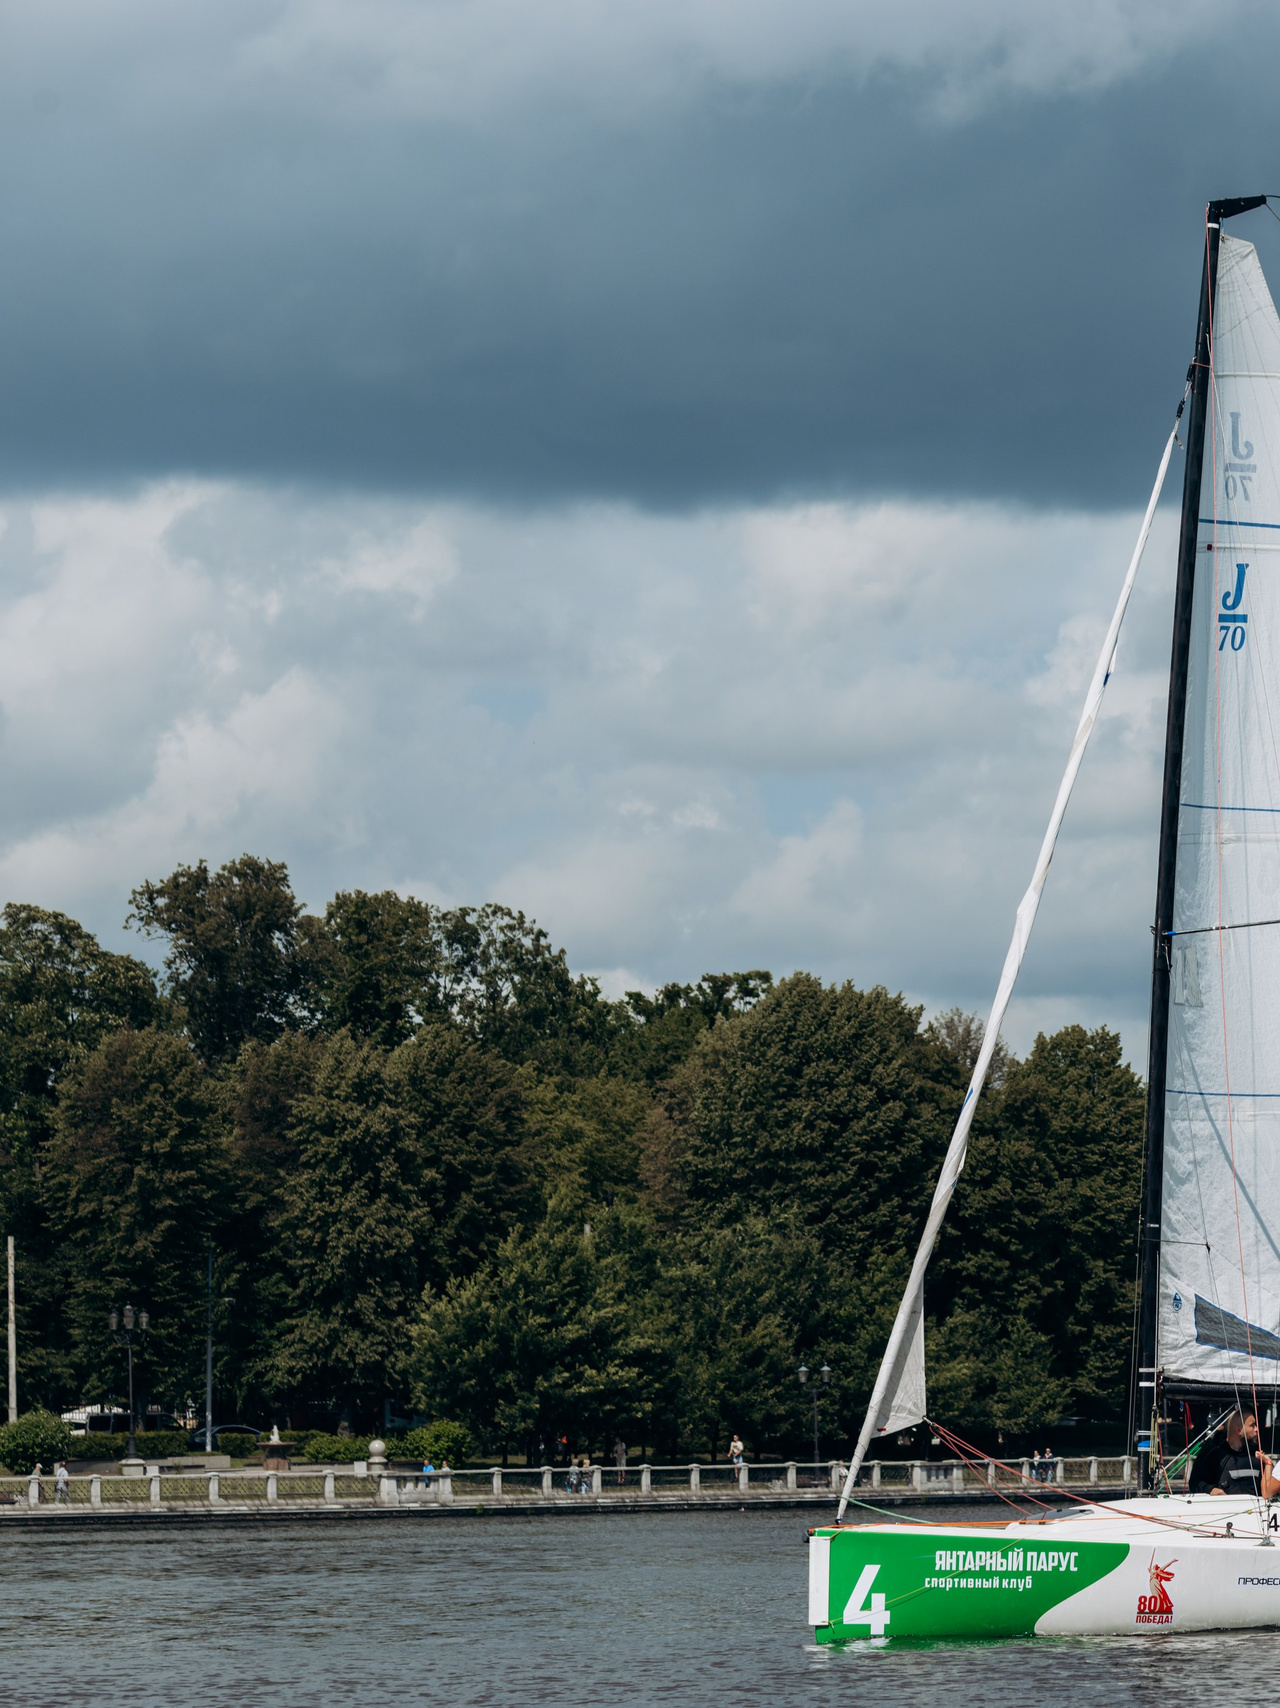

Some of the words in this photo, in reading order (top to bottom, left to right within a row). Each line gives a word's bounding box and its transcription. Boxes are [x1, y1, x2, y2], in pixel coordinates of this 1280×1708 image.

[1221, 562, 1249, 611] J
[1218, 625, 1246, 651] 70
[1269, 1513, 1280, 1532] 4
[934, 1547, 1024, 1572] ЯНТАРНЫЙ
[1026, 1550, 1079, 1572] ПАРУС
[924, 1573, 1000, 1591] спортивный
[1002, 1574, 1033, 1590] клуб
[842, 1564, 891, 1635] 4
[1137, 1595, 1158, 1612] 80
[1135, 1614, 1173, 1625] ПОБЕДА!
